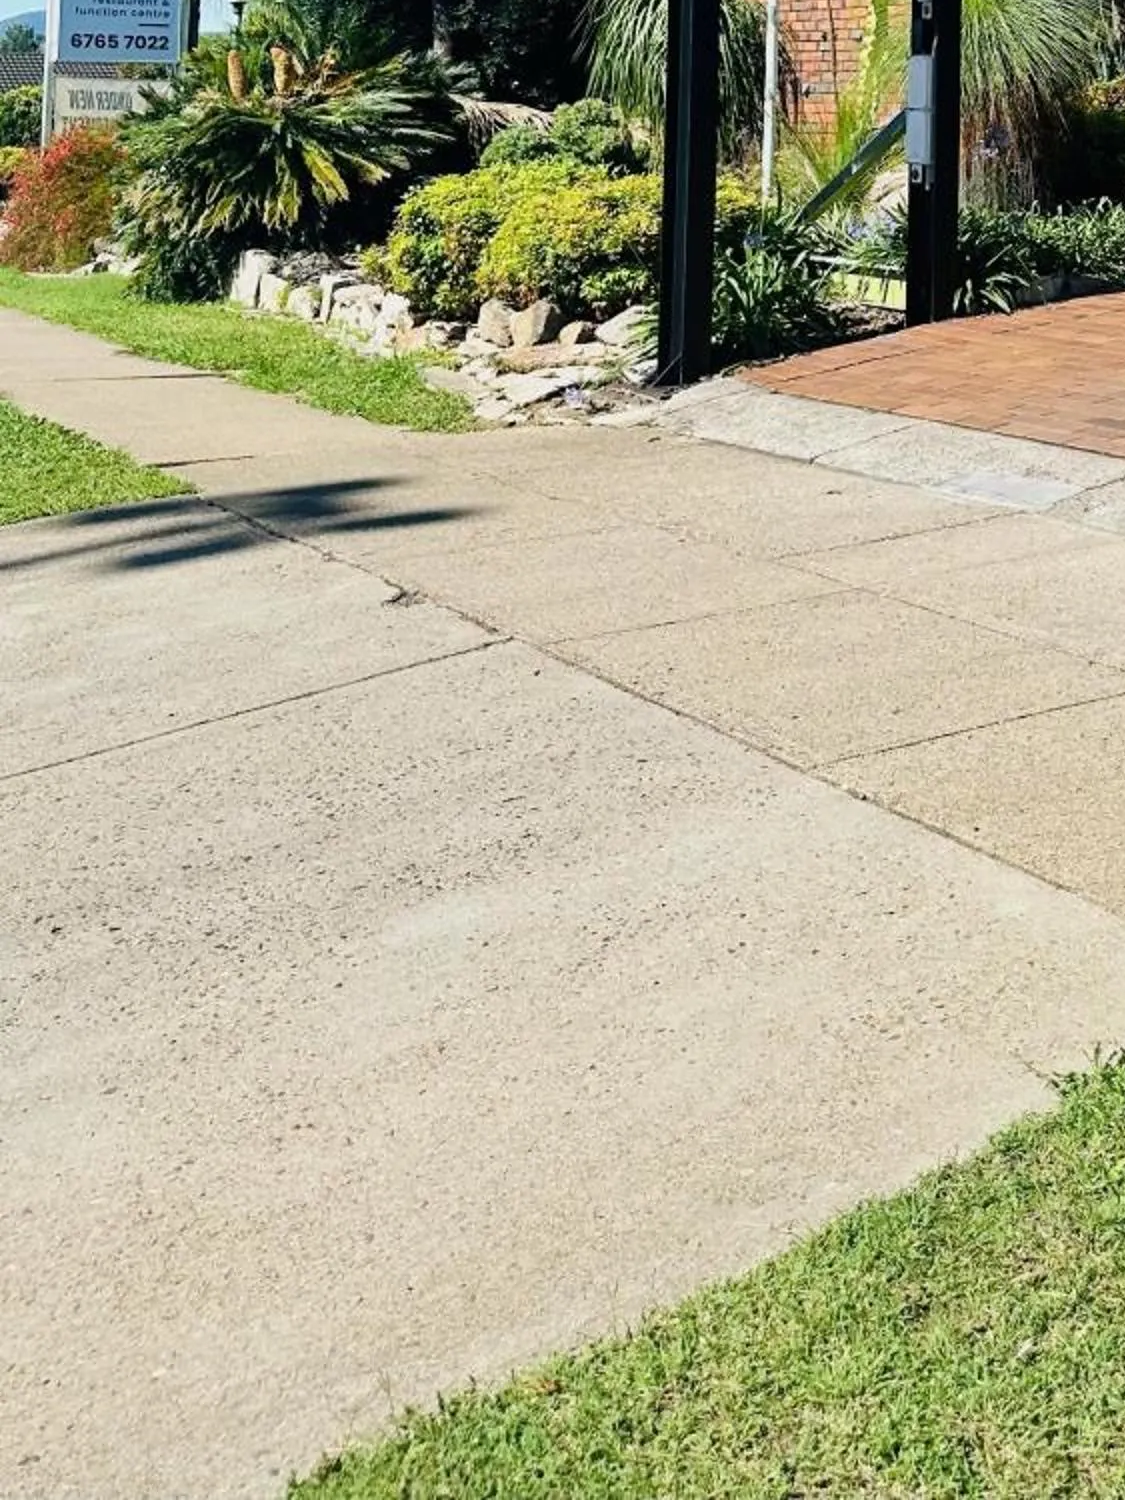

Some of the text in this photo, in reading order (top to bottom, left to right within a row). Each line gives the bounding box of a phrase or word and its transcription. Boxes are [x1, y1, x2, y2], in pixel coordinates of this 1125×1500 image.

[75, 6, 170, 18] function centre
[71, 33, 169, 51] 6765 7022
